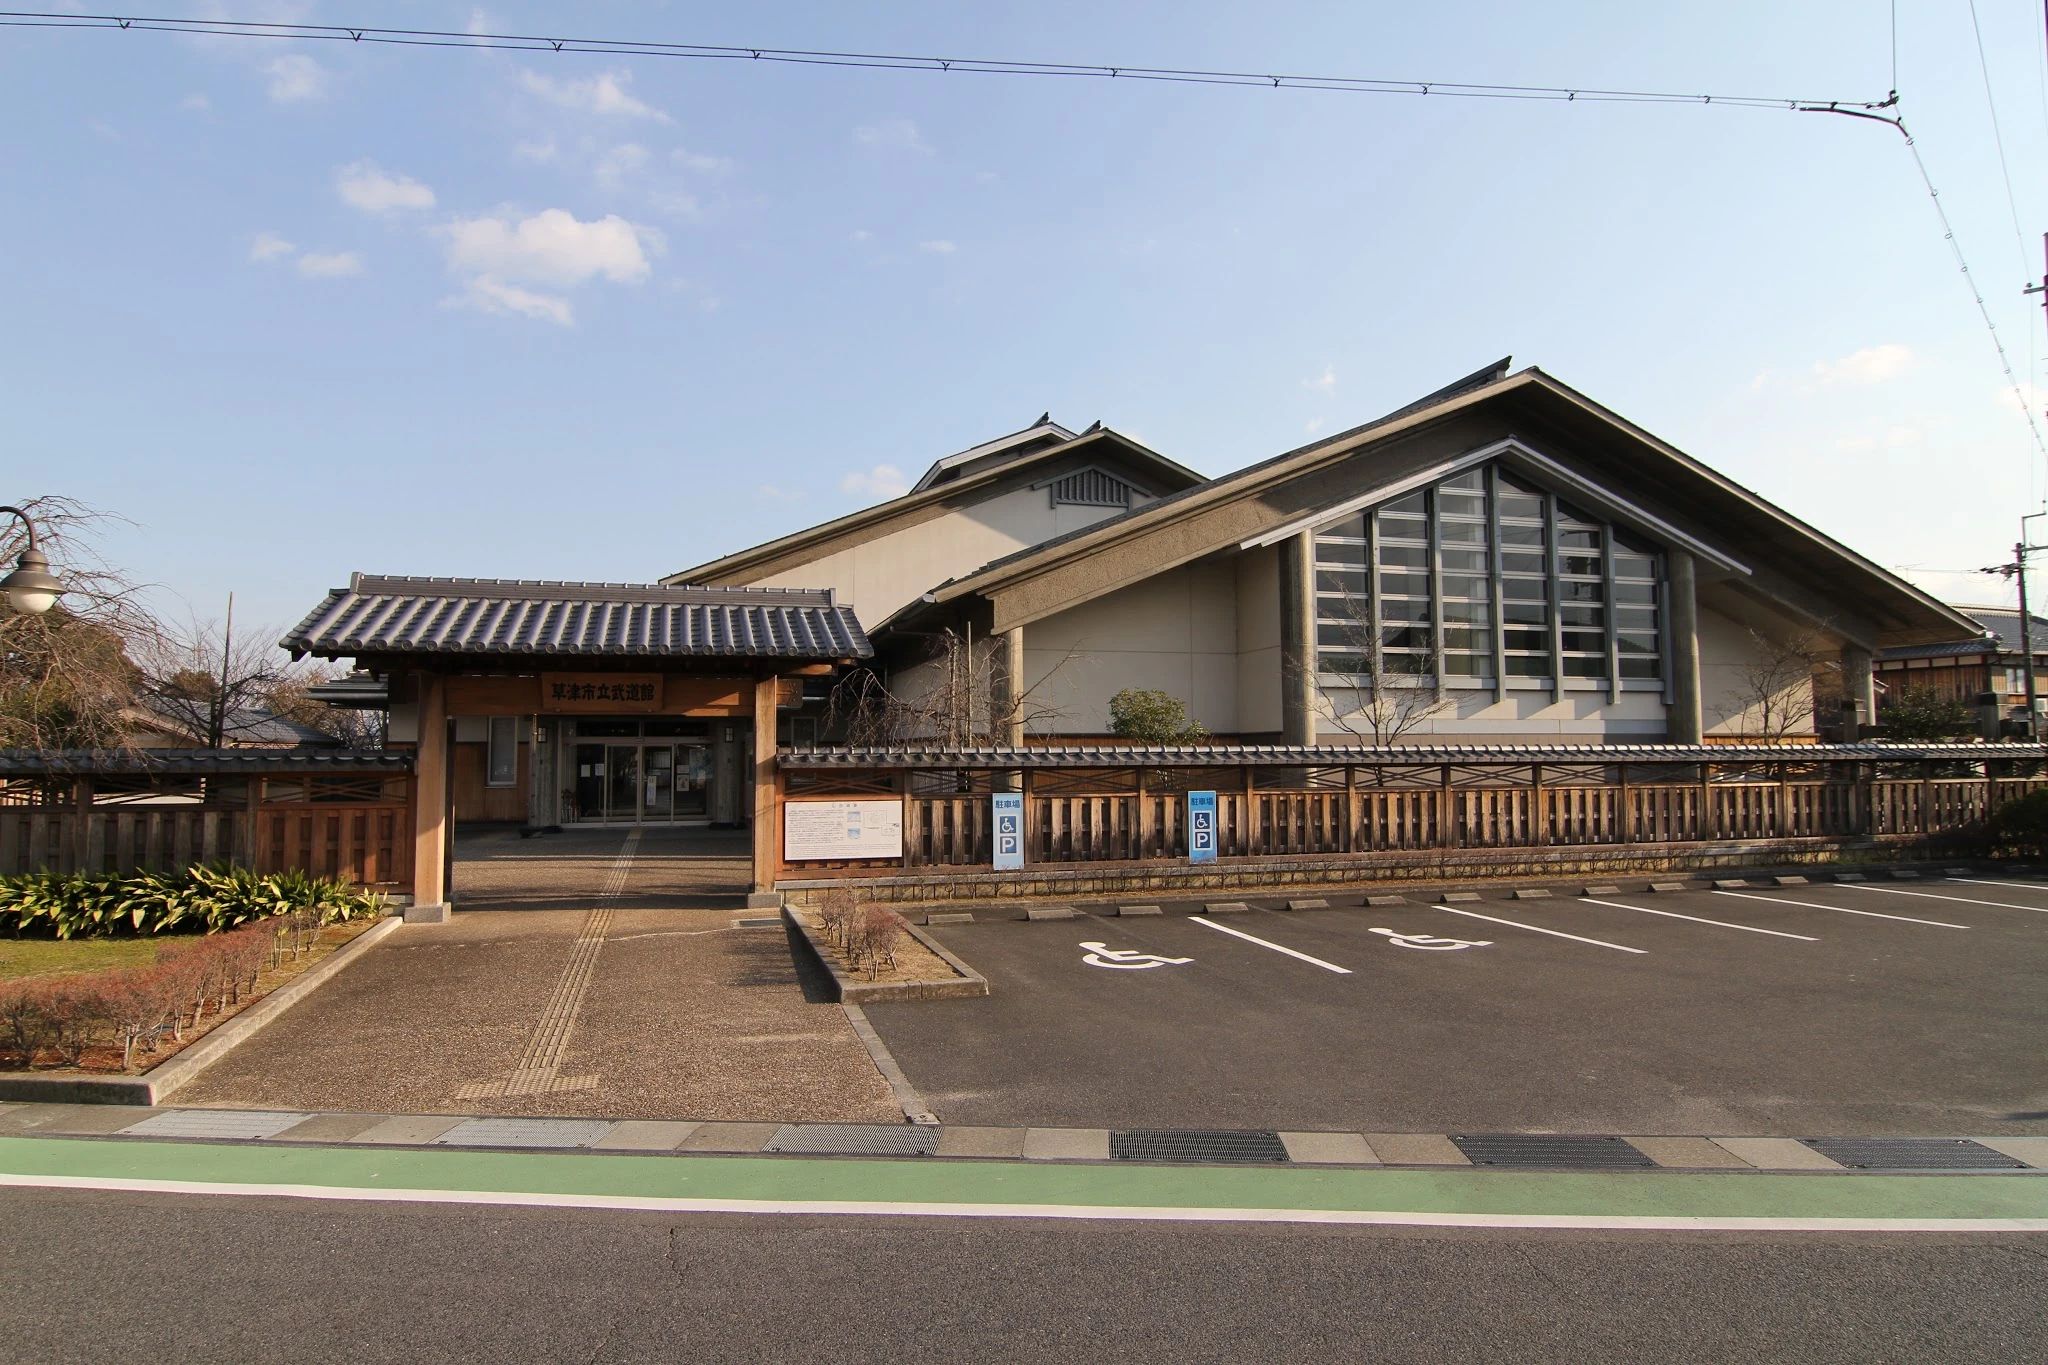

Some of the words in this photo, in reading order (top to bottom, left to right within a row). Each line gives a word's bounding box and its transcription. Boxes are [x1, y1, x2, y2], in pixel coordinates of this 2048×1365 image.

[551, 682, 655, 702] 草津市立武道館
[995, 799, 1020, 809] 駐車場
[1191, 797, 1213, 806] 駐車場
[1002, 838, 1015, 853] P
[1197, 833, 1209, 848] P
